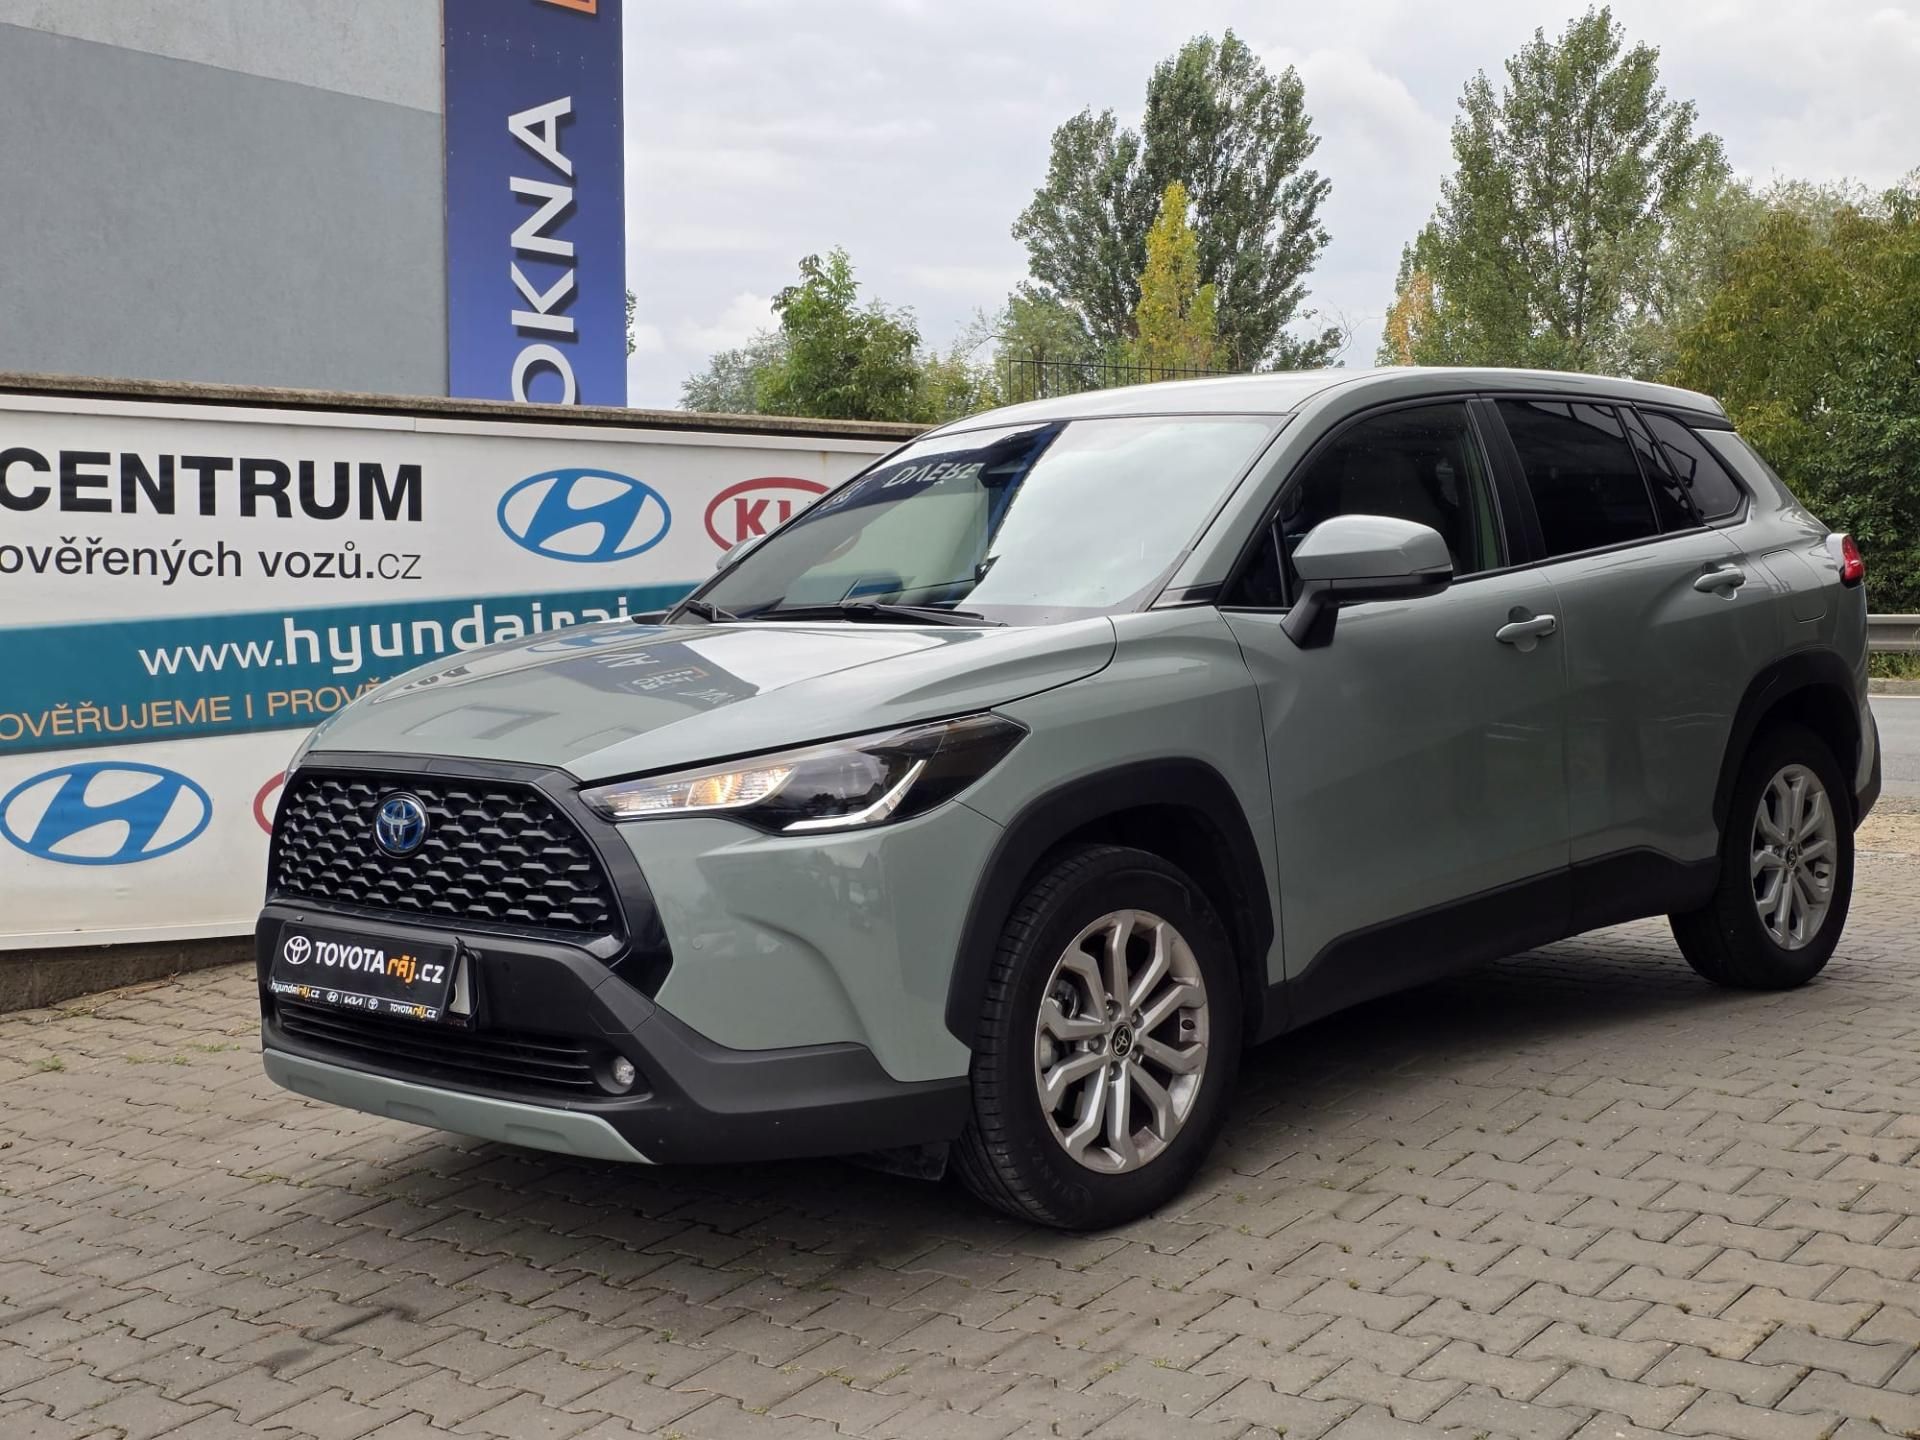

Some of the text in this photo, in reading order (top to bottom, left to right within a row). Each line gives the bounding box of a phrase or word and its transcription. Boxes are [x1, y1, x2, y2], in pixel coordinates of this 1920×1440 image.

[508, 96, 576, 405] OKNA
[0, 447, 423, 521] CENTRUM
[0, 536, 422, 585] ověřených vozů.cz
[0, 695, 232, 740] OVĚŘUJEME
